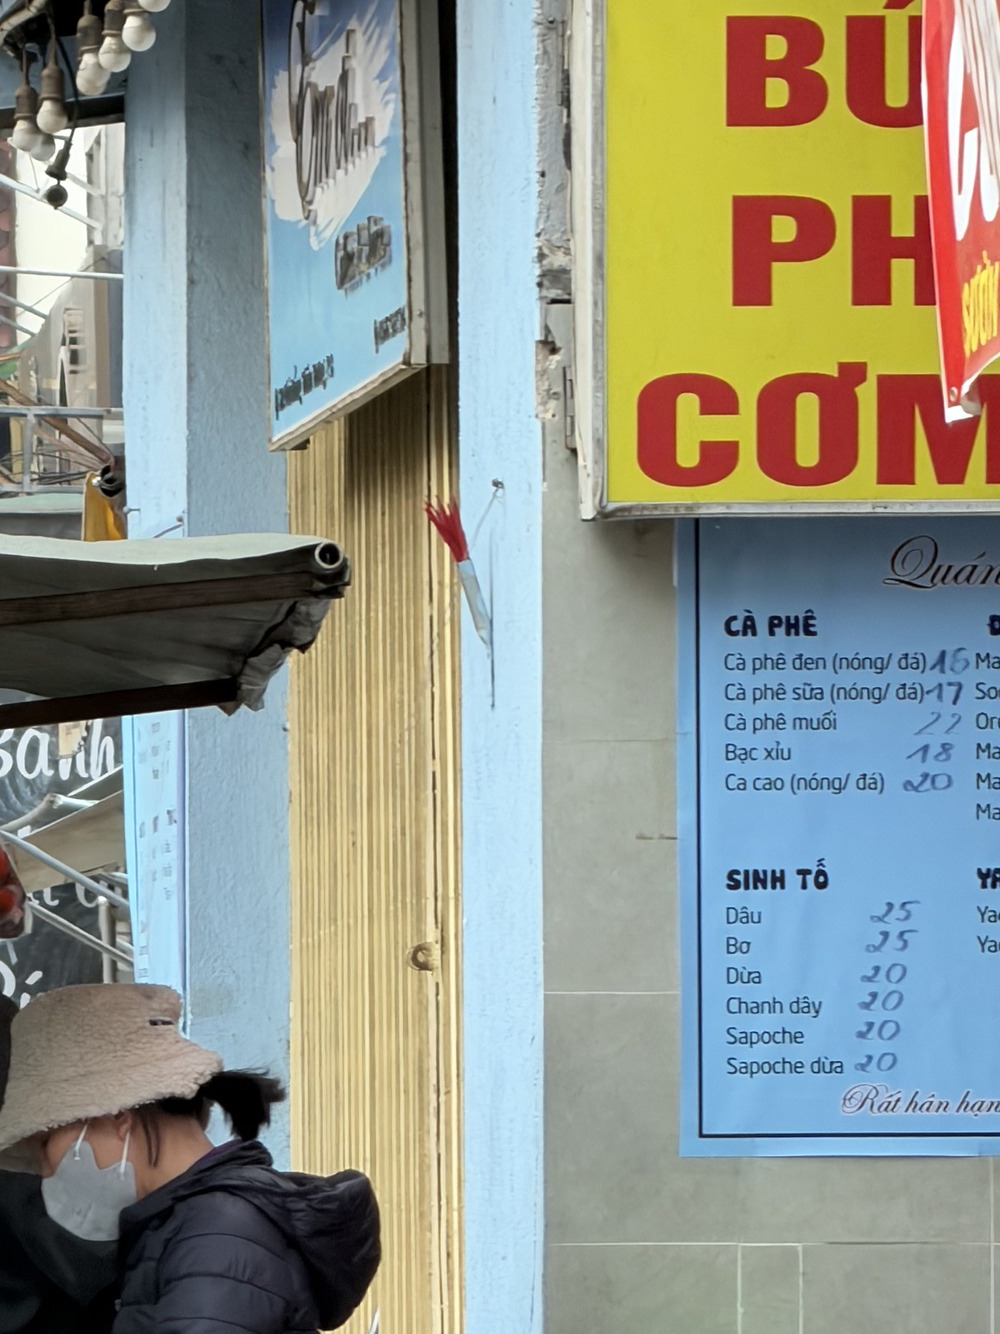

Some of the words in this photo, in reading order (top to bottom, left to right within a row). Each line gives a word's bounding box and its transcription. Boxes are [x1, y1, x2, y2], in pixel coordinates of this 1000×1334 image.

[637, 361, 1000, 486] CƠM
[724, 609, 757, 637] CÀ
[768, 608, 818, 637] PHÊ
[724, 652, 746, 671] Cà
[752, 652, 786, 675] phê
[792, 652, 827, 671] đen
[724, 683, 746, 701] Cà
[752, 682, 786, 705] phê
[792, 682, 825, 701] sữa
[975, 682, 1000, 701] So
[724, 712, 746, 731] Cà
[752, 712, 786, 735] phê
[792, 709, 837, 731] muối
[725, 743, 757, 764] Bạc
[763, 740, 791, 762] xỉu
[905, 742, 955, 763] 18
[725, 773, 747, 791] Ca
[753, 777, 785, 791] cao
[902, 772, 954, 793] 20
[725, 868, 785, 891] SINH
[796, 858, 829, 891] TỐ
[726, 906, 762, 925] Dâu
[870, 900, 921, 924] 25
[726, 937, 752, 955] Bơ
[865, 929, 919, 953] 25
[726, 966, 762, 985] Dừa
[860, 963, 907, 984] 20
[726, 997, 783, 1015] Chanh
[789, 996, 822, 1018] dây
[857, 990, 904, 1012] 20
[726, 1027, 804, 1048] Sapoche
[855, 1019, 901, 1041] 20
[726, 1057, 805, 1078] Sapoche
[810, 1056, 844, 1075] dừa
[854, 1052, 897, 1073] 20
[841, 1083, 903, 1115] Rất
[904, 1089, 950, 1114] hân
